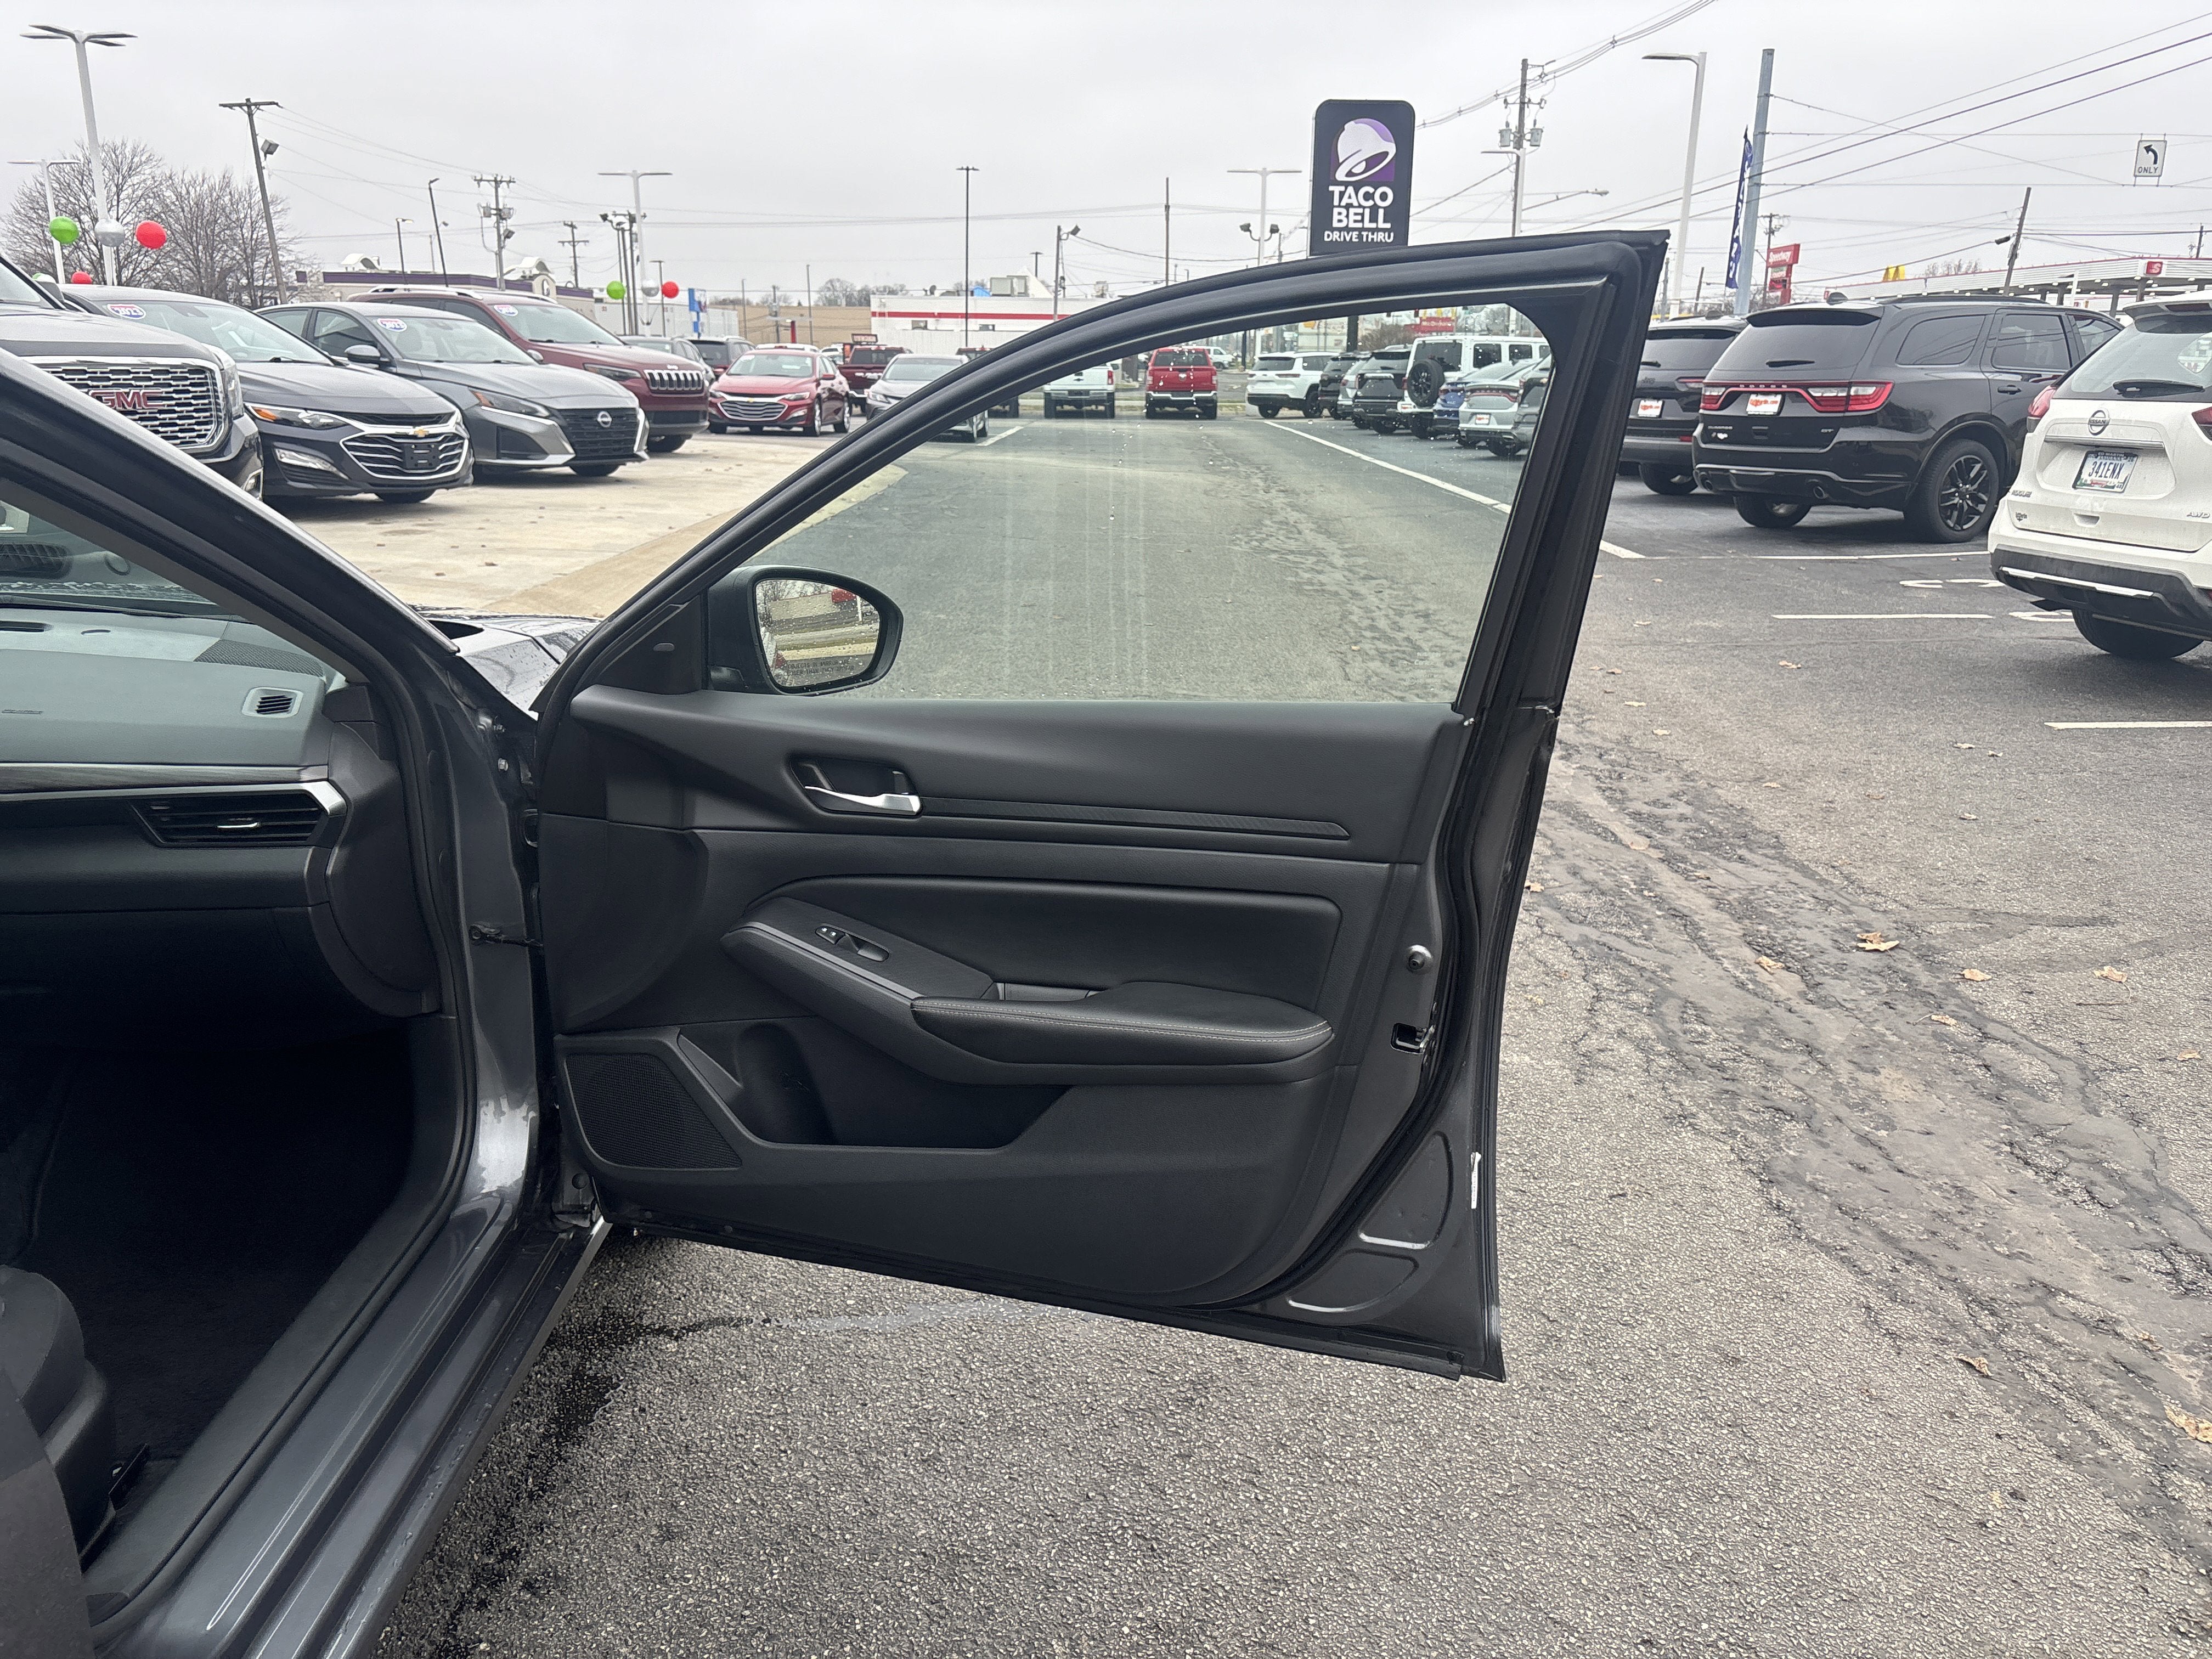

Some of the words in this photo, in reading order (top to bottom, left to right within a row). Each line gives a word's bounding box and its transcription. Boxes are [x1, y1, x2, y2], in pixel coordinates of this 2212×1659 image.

[1328, 185, 1393, 207] TACO
[1332, 207, 1391, 228] BELL
[1324, 230, 1359, 242] DRIVE
[1362, 231, 1394, 242] THRU
[89, 390, 163, 409] GMC
[2088, 461, 2125, 479] 341ENX
[2186, 511, 2210, 519] AWD
